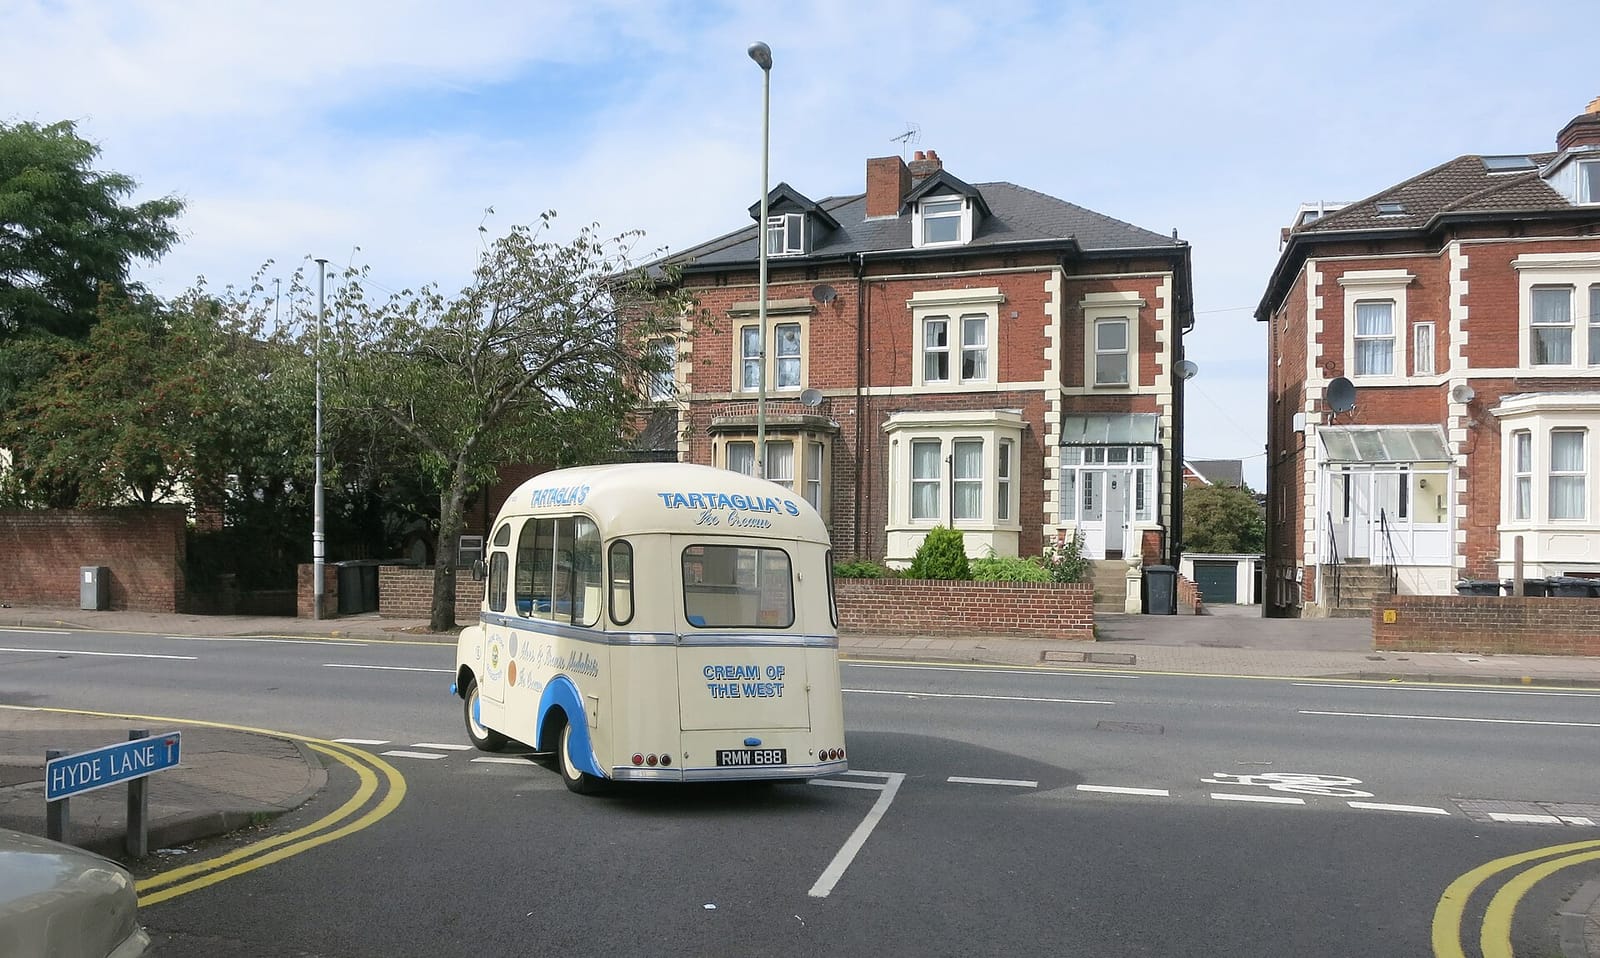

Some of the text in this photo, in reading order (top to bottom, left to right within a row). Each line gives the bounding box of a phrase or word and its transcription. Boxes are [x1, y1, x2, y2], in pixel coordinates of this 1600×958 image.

[531, 484, 590, 508] TARTAGLIA'S
[657, 492, 800, 517] TARTAGLIA'S
[695, 510, 772, 529] Ice Cream
[703, 665, 785, 681] CREAM OF
[707, 683, 784, 698] THE WEST
[722, 750, 782, 765] RMW 688
[52, 746, 156, 792] HYDE LANE
